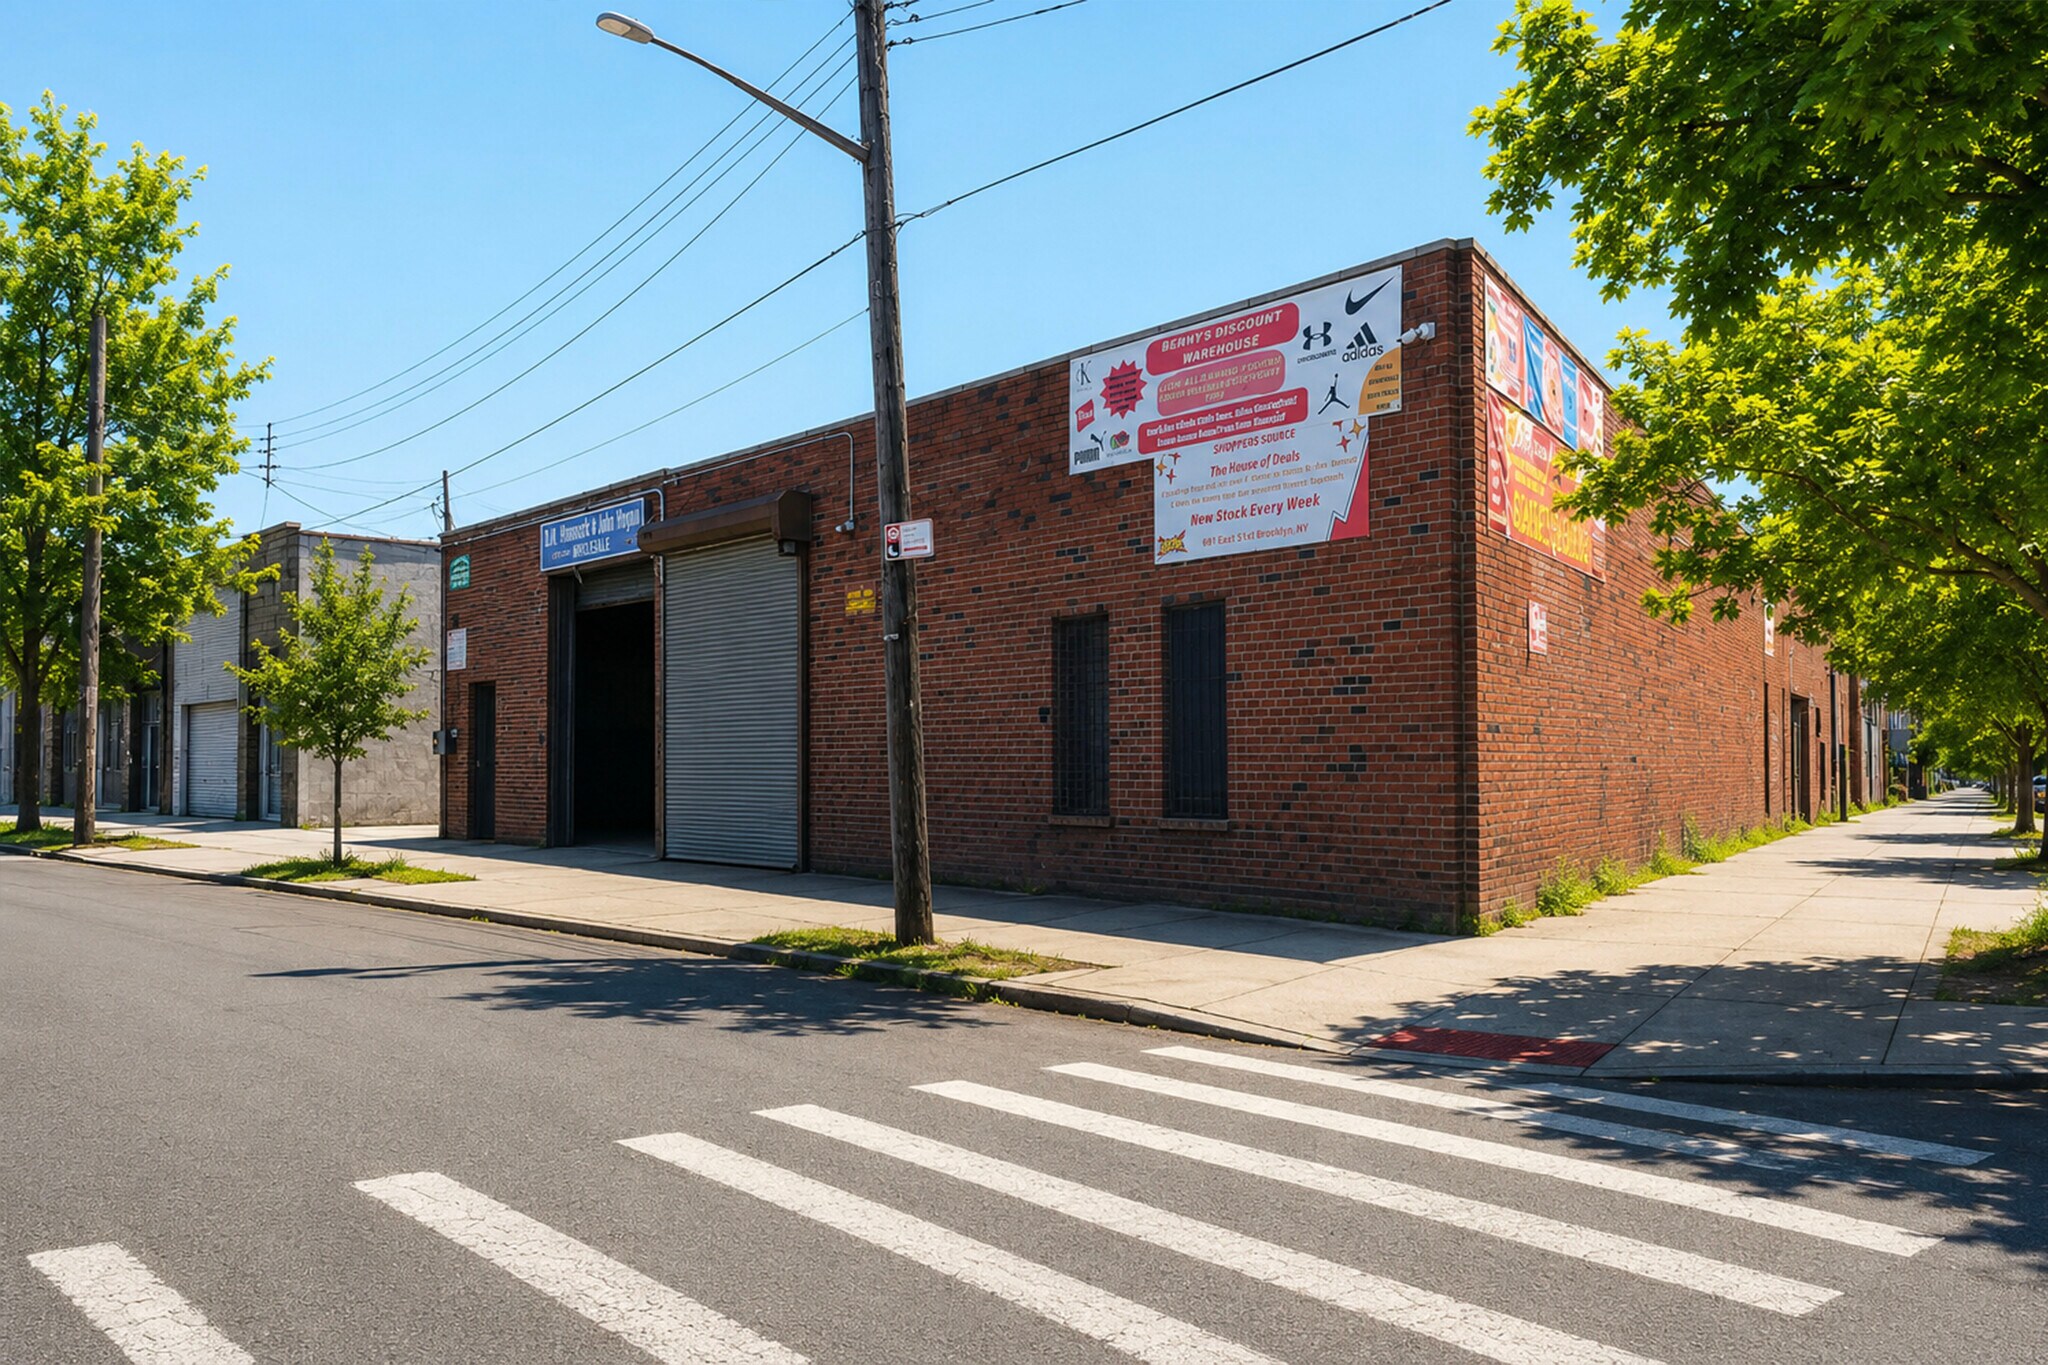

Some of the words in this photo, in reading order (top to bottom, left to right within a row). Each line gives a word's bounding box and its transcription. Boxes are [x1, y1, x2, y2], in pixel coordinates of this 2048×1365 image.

[1215, 309, 1283, 338] DISCOUNT
[1182, 334, 1260, 365] WAREHOUSE
[1342, 345, 1384, 362] adidas
[1210, 465, 1227, 478] The
[1229, 459, 1258, 474] House
[1260, 454, 1271, 469] of
[1272, 449, 1300, 466] Deals
[1190, 513, 1212, 526] New
[1215, 505, 1248, 522] Stock
[1250, 501, 1283, 517] Every
[1286, 493, 1321, 511] Week
[1296, 523, 1309, 533] NY
